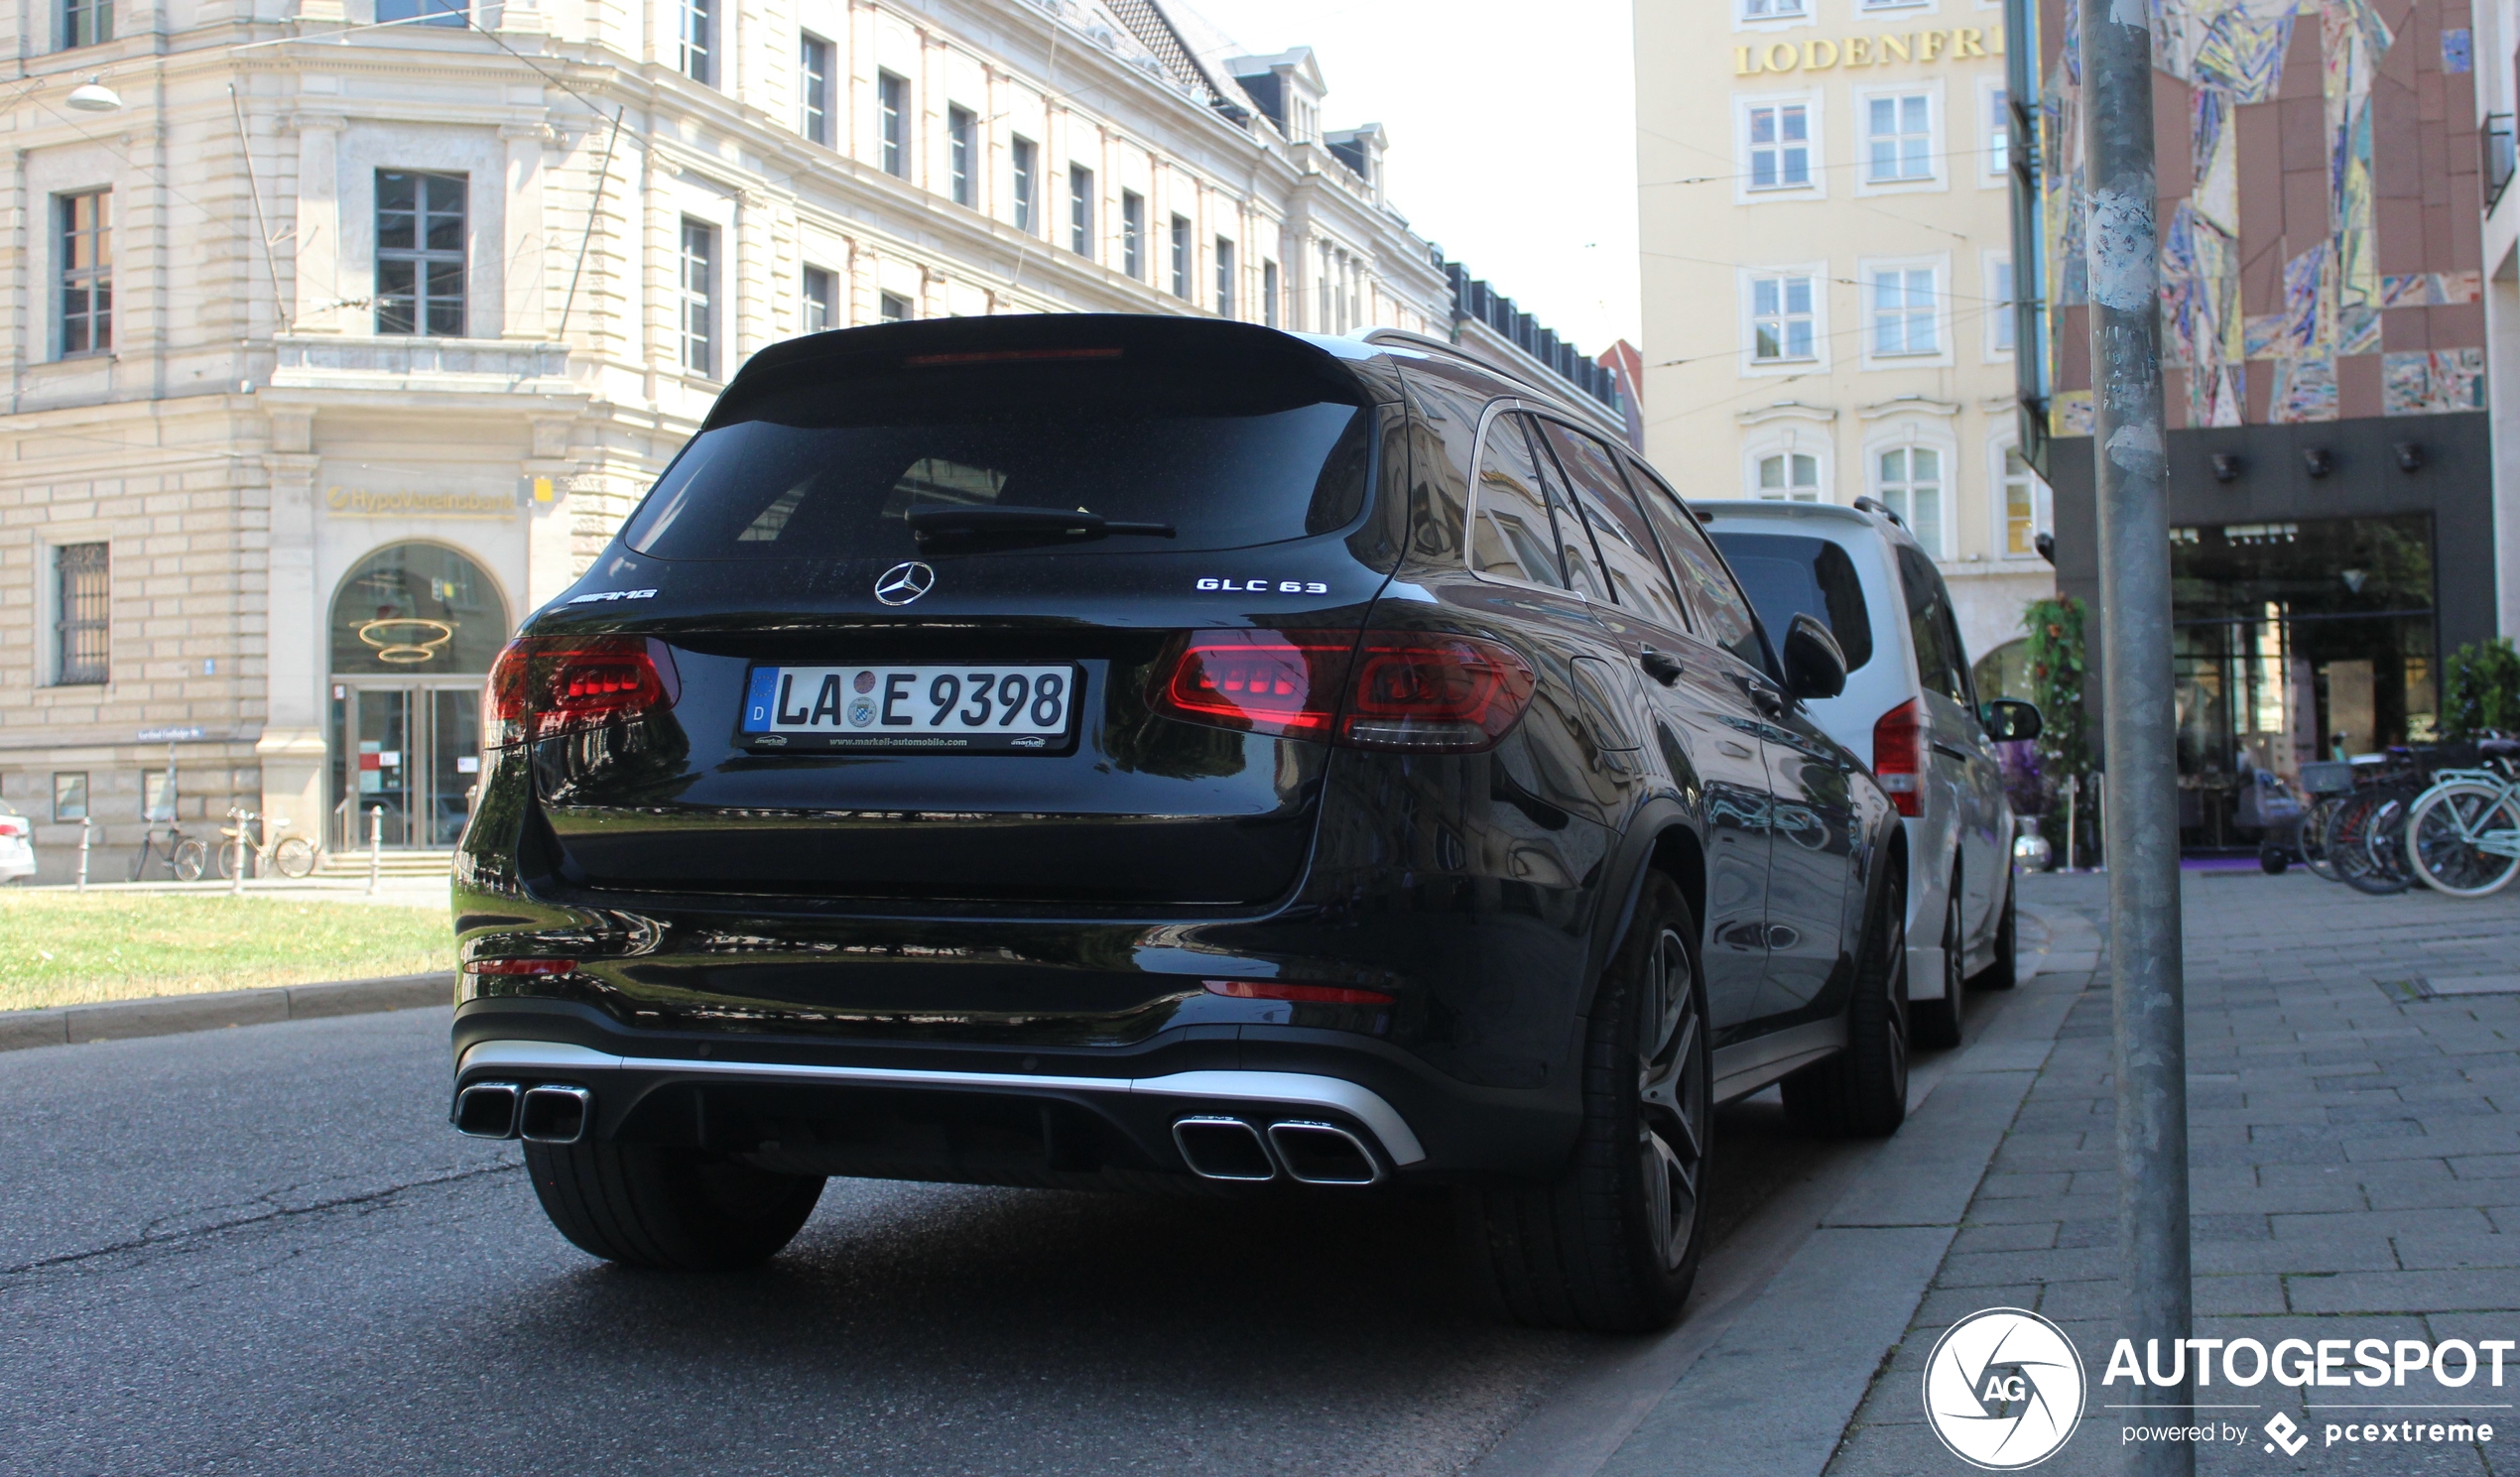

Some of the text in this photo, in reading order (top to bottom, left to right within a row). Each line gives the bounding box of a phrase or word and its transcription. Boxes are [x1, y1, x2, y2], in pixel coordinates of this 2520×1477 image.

[351, 488, 516, 513] HypoVereinsbank
[1197, 578, 1327, 593] GLC 63
[589, 589, 658, 601] AMG
[777, 675, 841, 726] LA
[881, 675, 917, 725] E
[930, 674, 1064, 726] 9398
[753, 706, 764, 720] D
